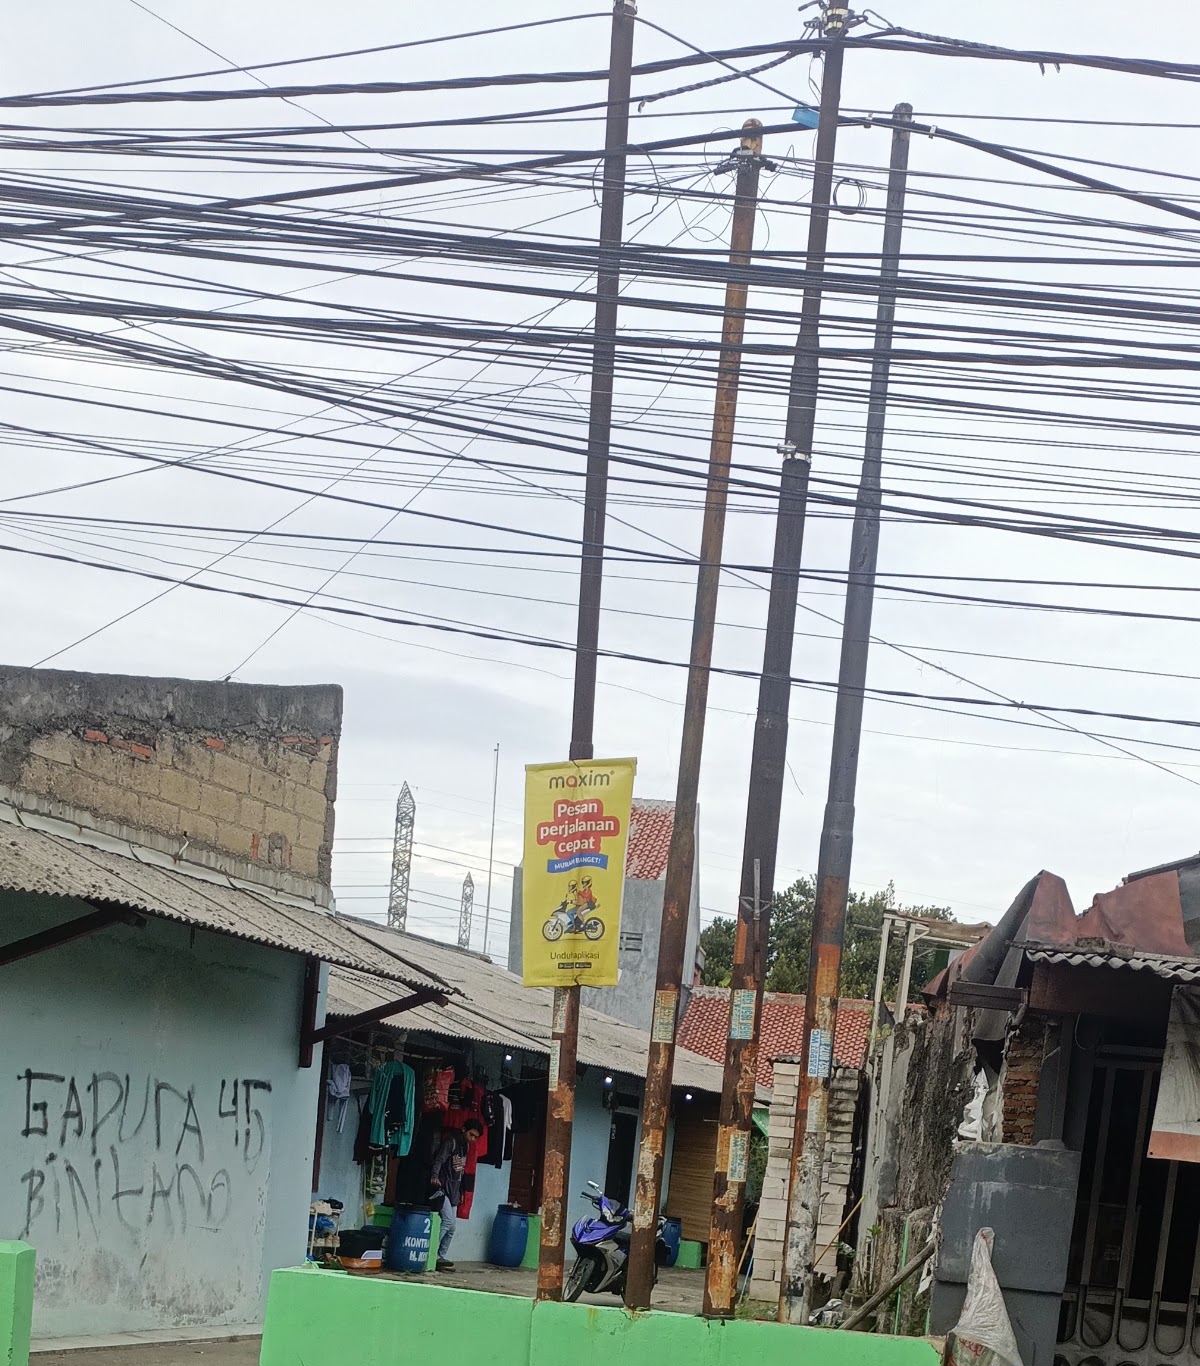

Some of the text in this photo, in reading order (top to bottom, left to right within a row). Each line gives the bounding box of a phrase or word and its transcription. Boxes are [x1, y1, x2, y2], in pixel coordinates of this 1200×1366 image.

[549, 770, 611, 789] maxim
[557, 802, 598, 818] Pesan
[540, 818, 615, 840] perjalanan
[558, 835, 596, 856] cepat
[811, 1029, 820, 1044] WC
[218, 1077, 273, 1175] 45
[423, 1217, 430, 1233] 2
